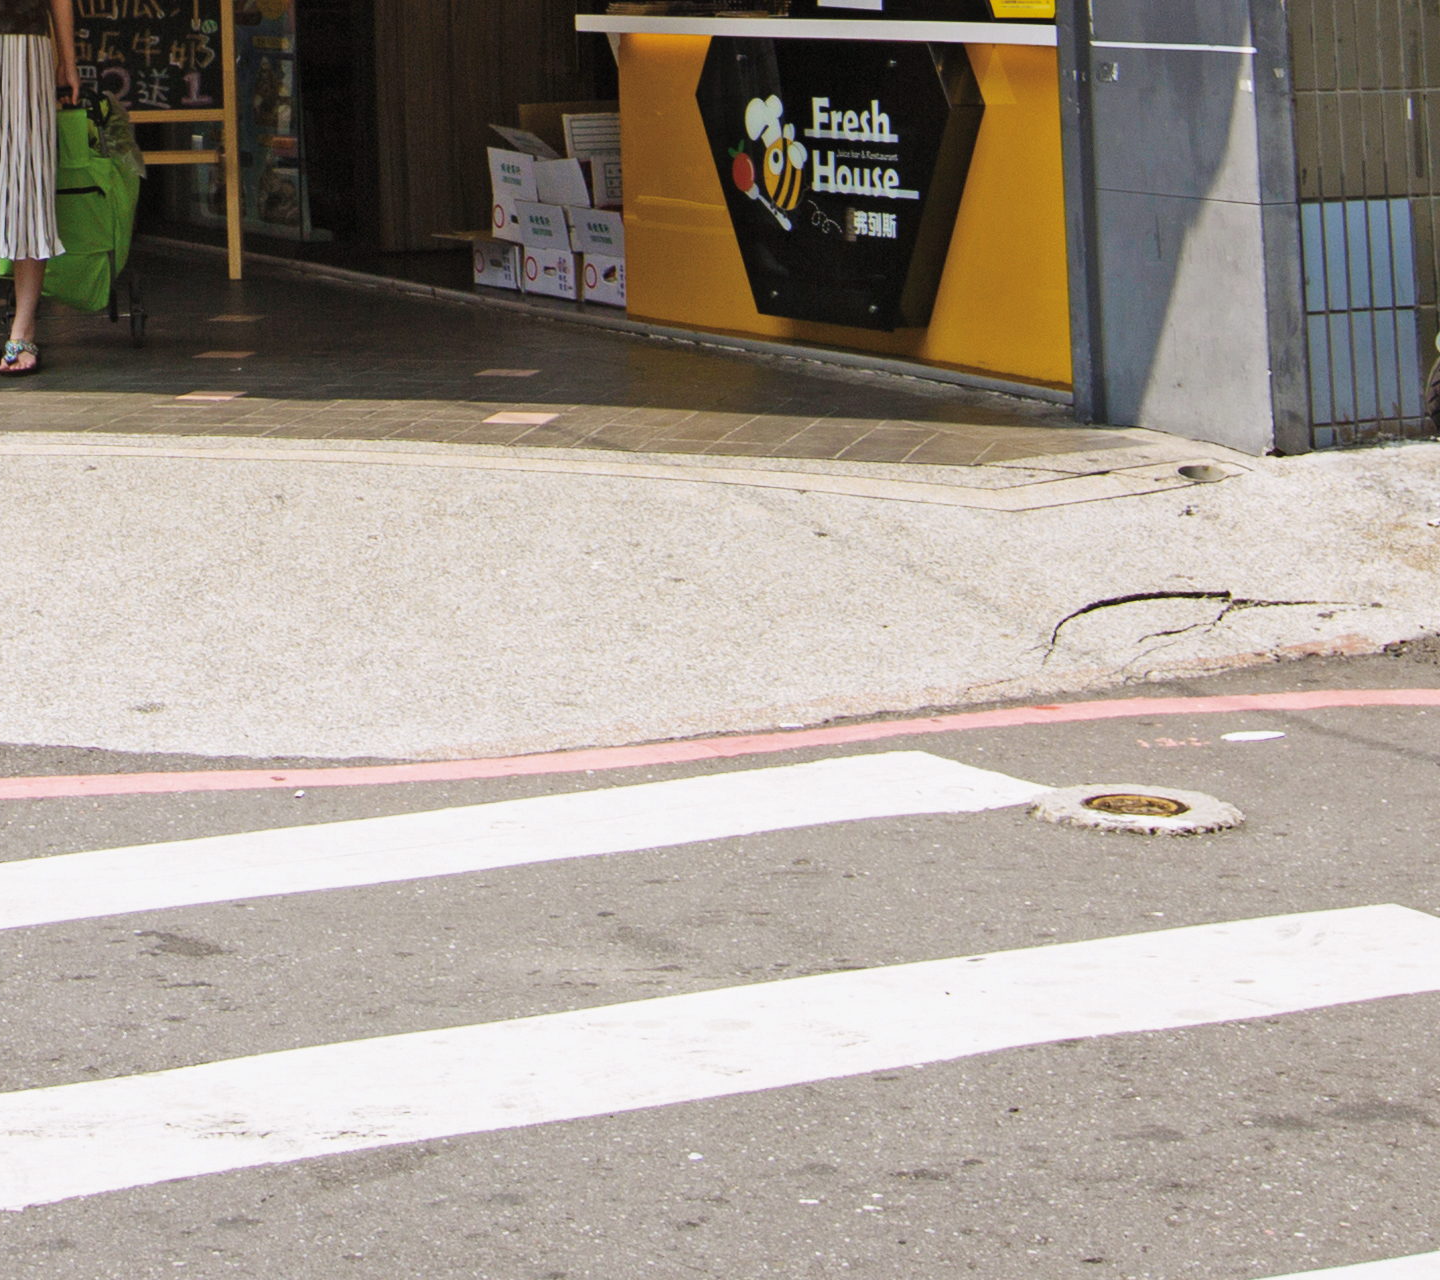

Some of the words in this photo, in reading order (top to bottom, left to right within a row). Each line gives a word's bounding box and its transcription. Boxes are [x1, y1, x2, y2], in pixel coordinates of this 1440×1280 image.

[812, 96, 891, 142] Fresh
[812, 149, 900, 199] House
[853, 210, 898, 239] 弗列斯
